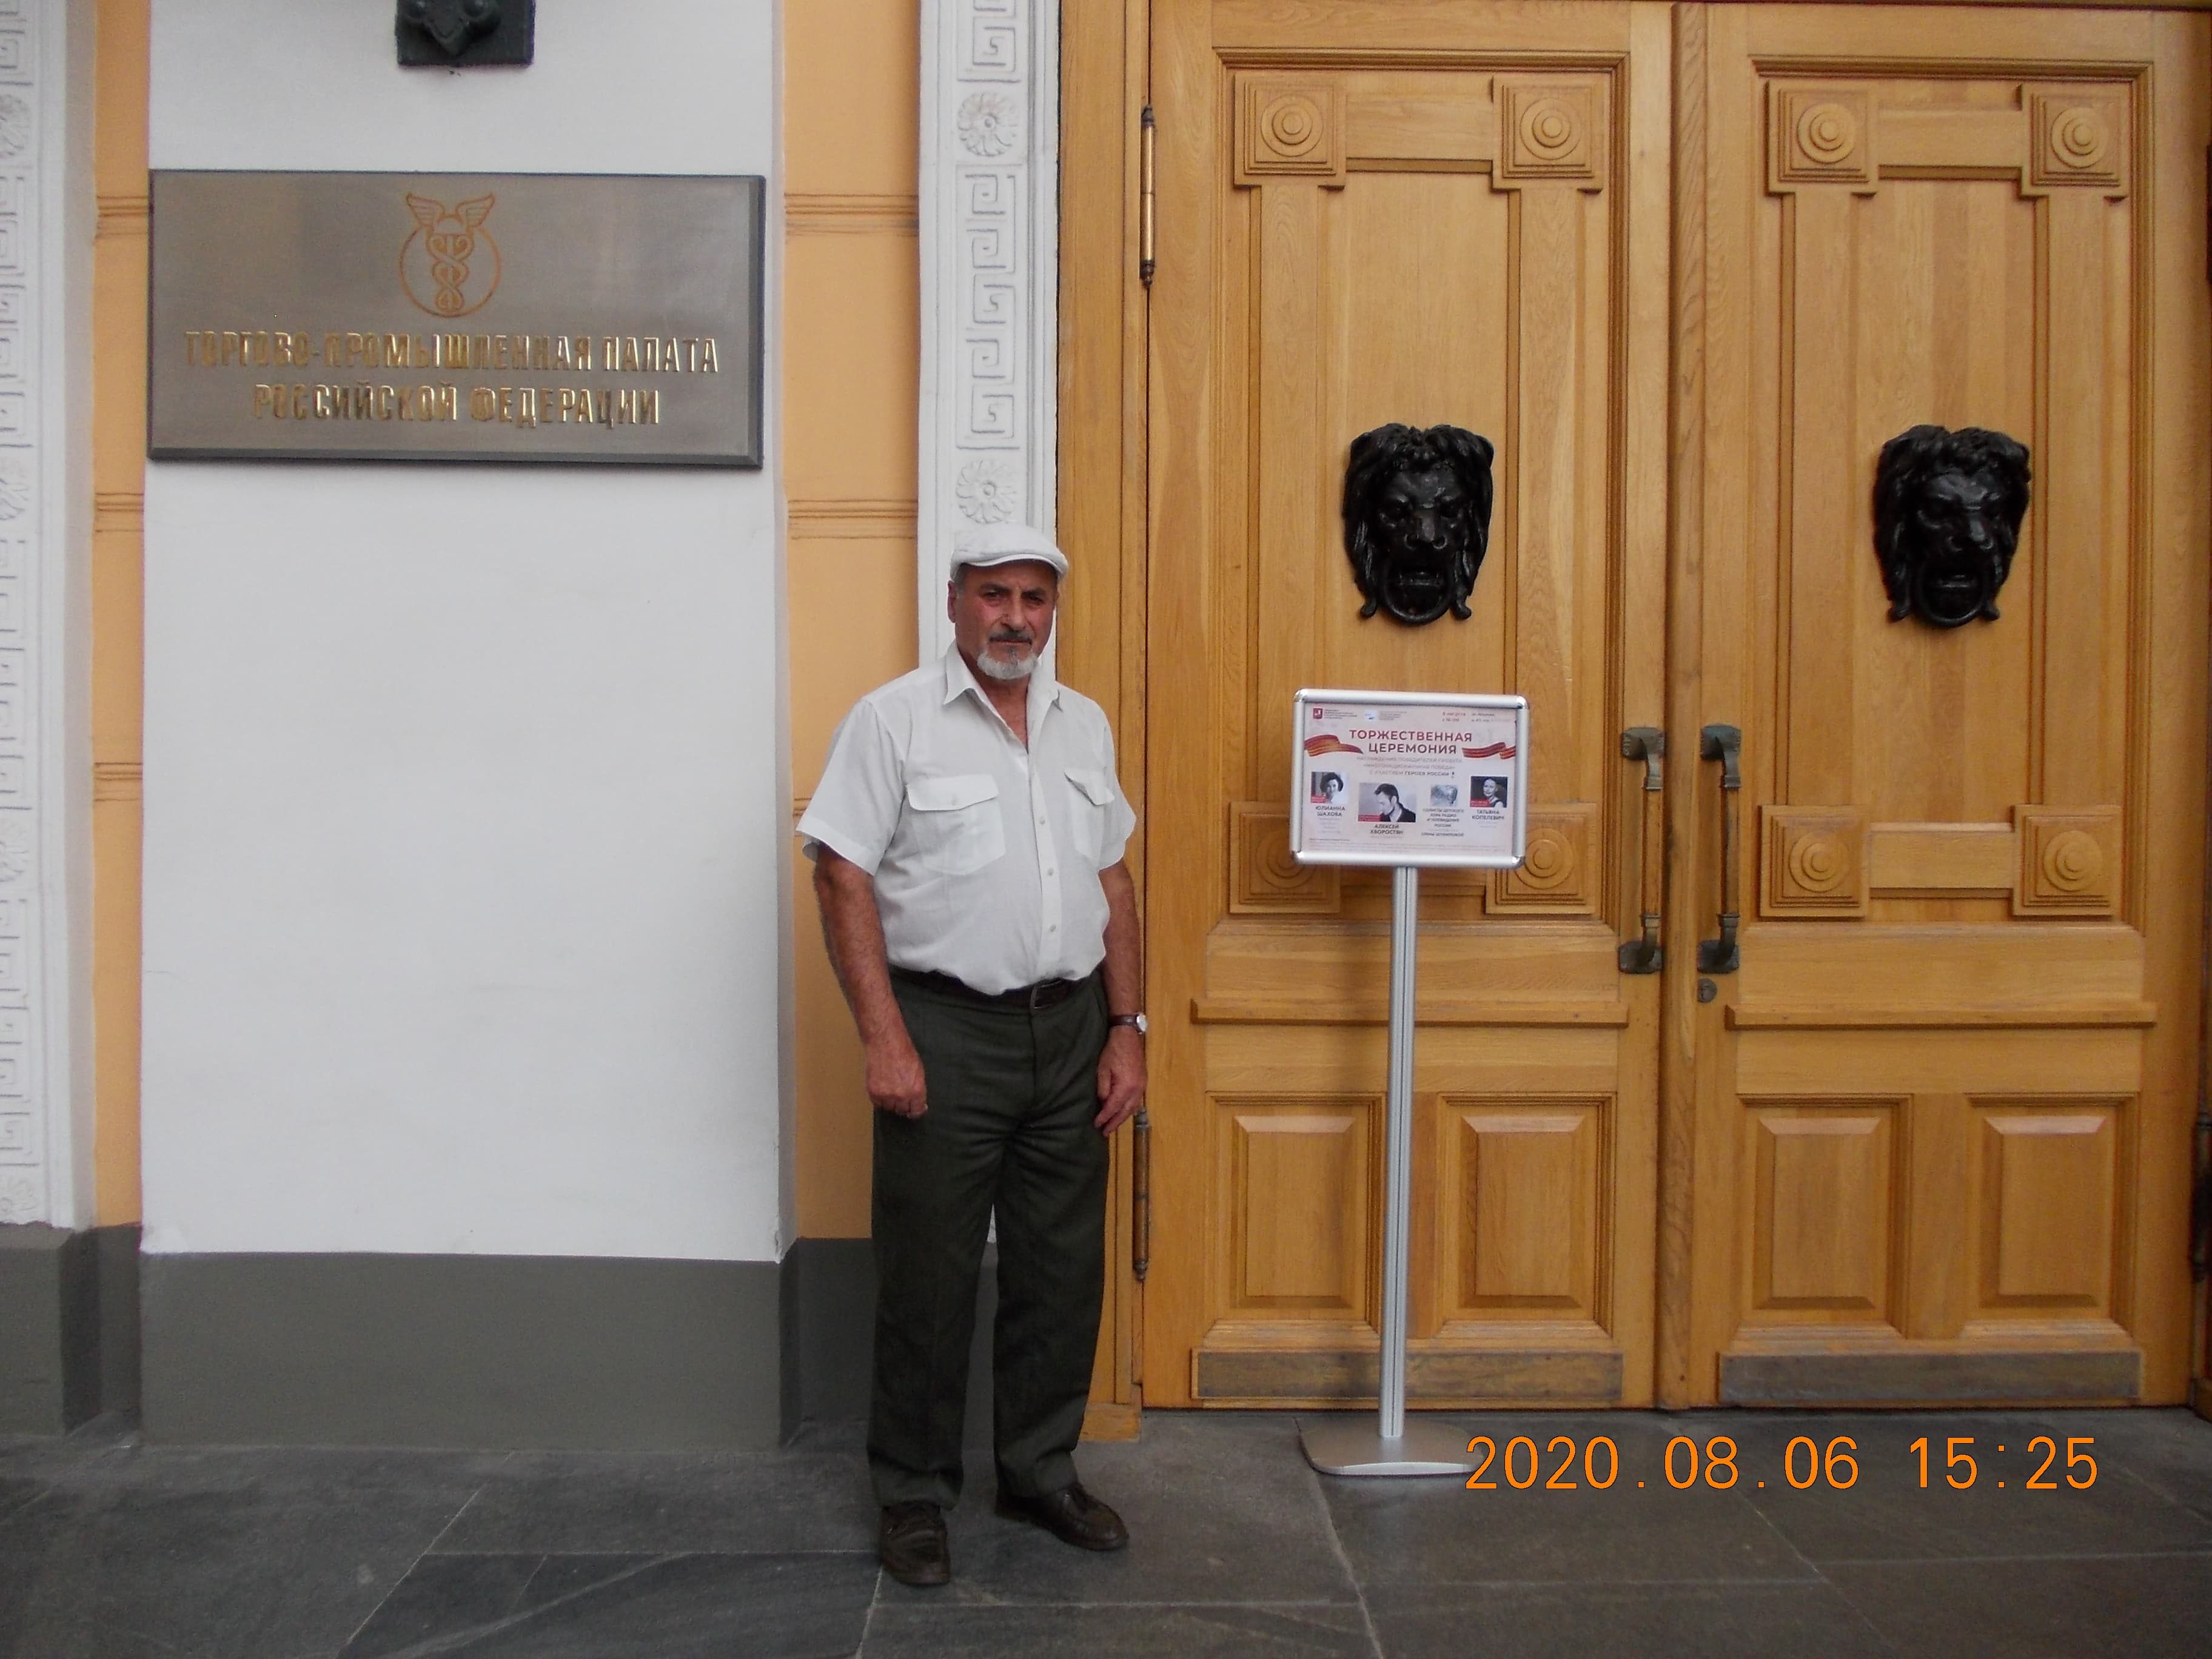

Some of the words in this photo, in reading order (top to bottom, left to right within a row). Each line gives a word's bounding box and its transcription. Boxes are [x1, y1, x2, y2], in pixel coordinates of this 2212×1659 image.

[184, 330, 592, 371] ТОРГОВО-ПРОМЫШЛЕННАЯ
[603, 336, 719, 372] ПАЛАТА
[254, 379, 457, 421] РОССИЙСКОЙ
[471, 387, 659, 429] ФЕДЕРАЦИИ
[1349, 729, 1472, 742] ТОРЖЕСТВЕННАЯ
[1369, 743, 1456, 754] ЦЕРЕМОНИЯ
